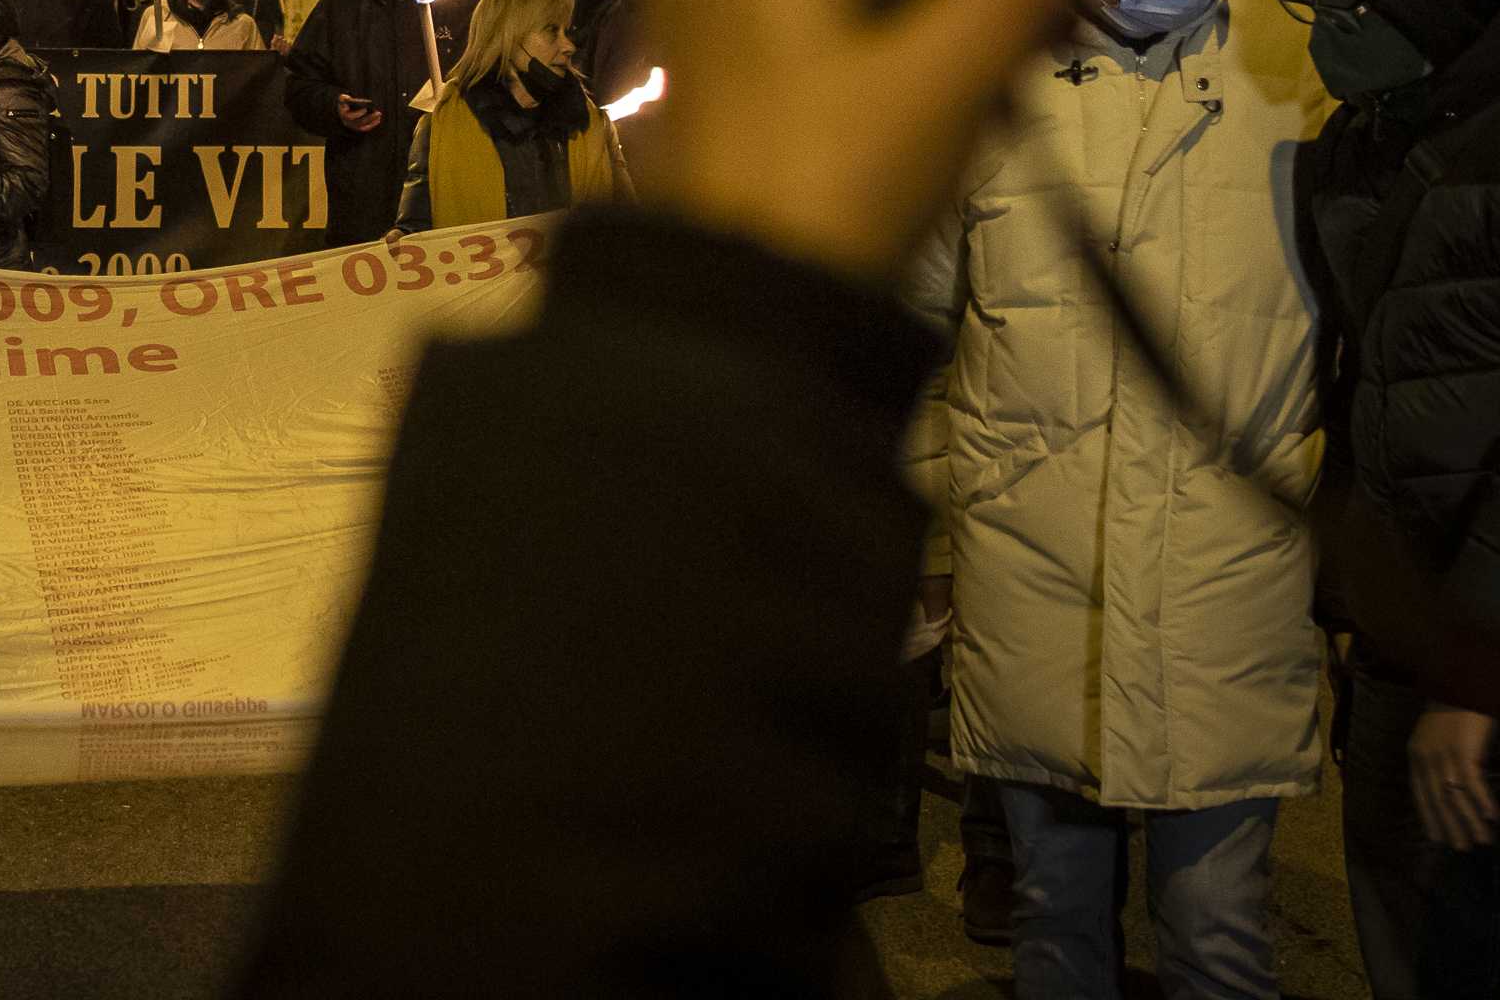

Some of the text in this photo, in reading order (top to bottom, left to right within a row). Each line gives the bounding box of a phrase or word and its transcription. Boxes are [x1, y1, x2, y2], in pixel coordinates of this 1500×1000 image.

[76, 73, 217, 119] TUTTI
[192, 145, 329, 229] VIT
[159, 261, 325, 317] ORE
